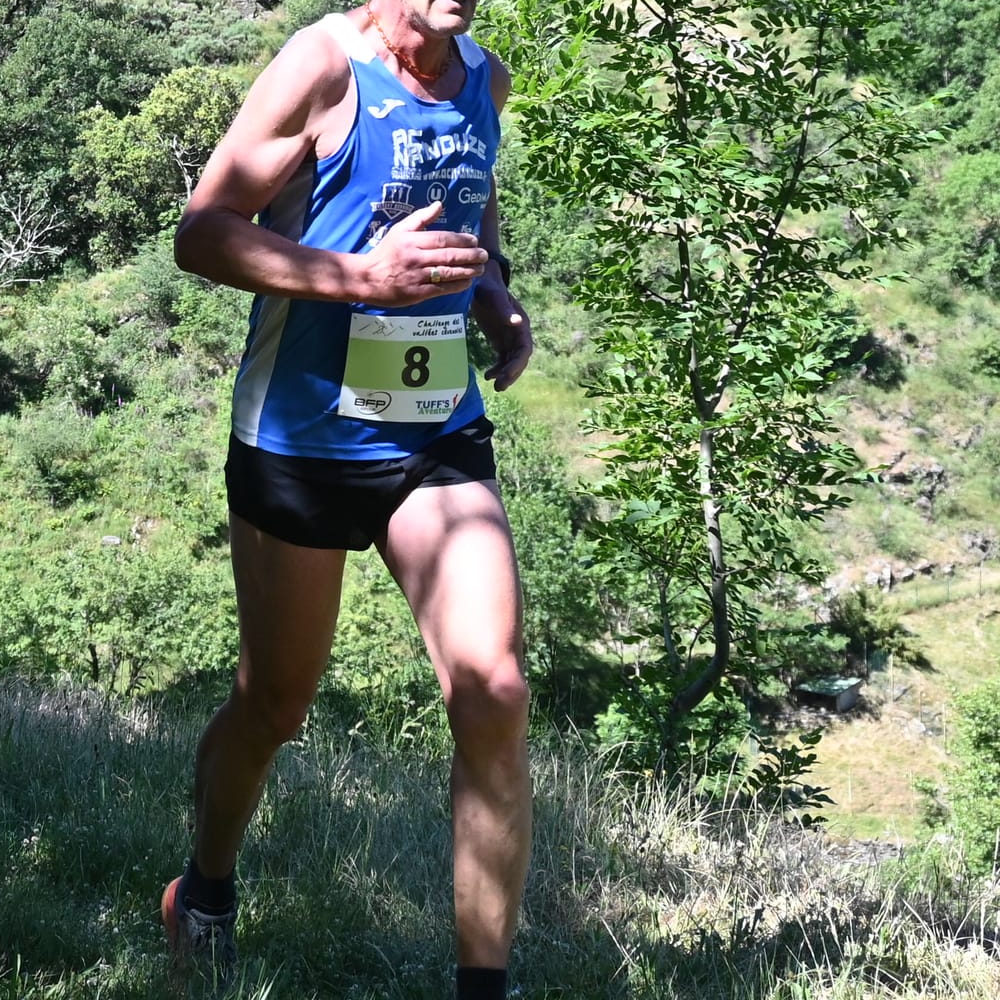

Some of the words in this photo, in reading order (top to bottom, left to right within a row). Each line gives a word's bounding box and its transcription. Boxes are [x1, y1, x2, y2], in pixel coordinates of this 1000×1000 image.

[417, 319, 450, 329] Challenge
[401, 346, 430, 388] 8
[354, 398, 386, 408] BFP
[415, 400, 450, 409] TUFF'S
